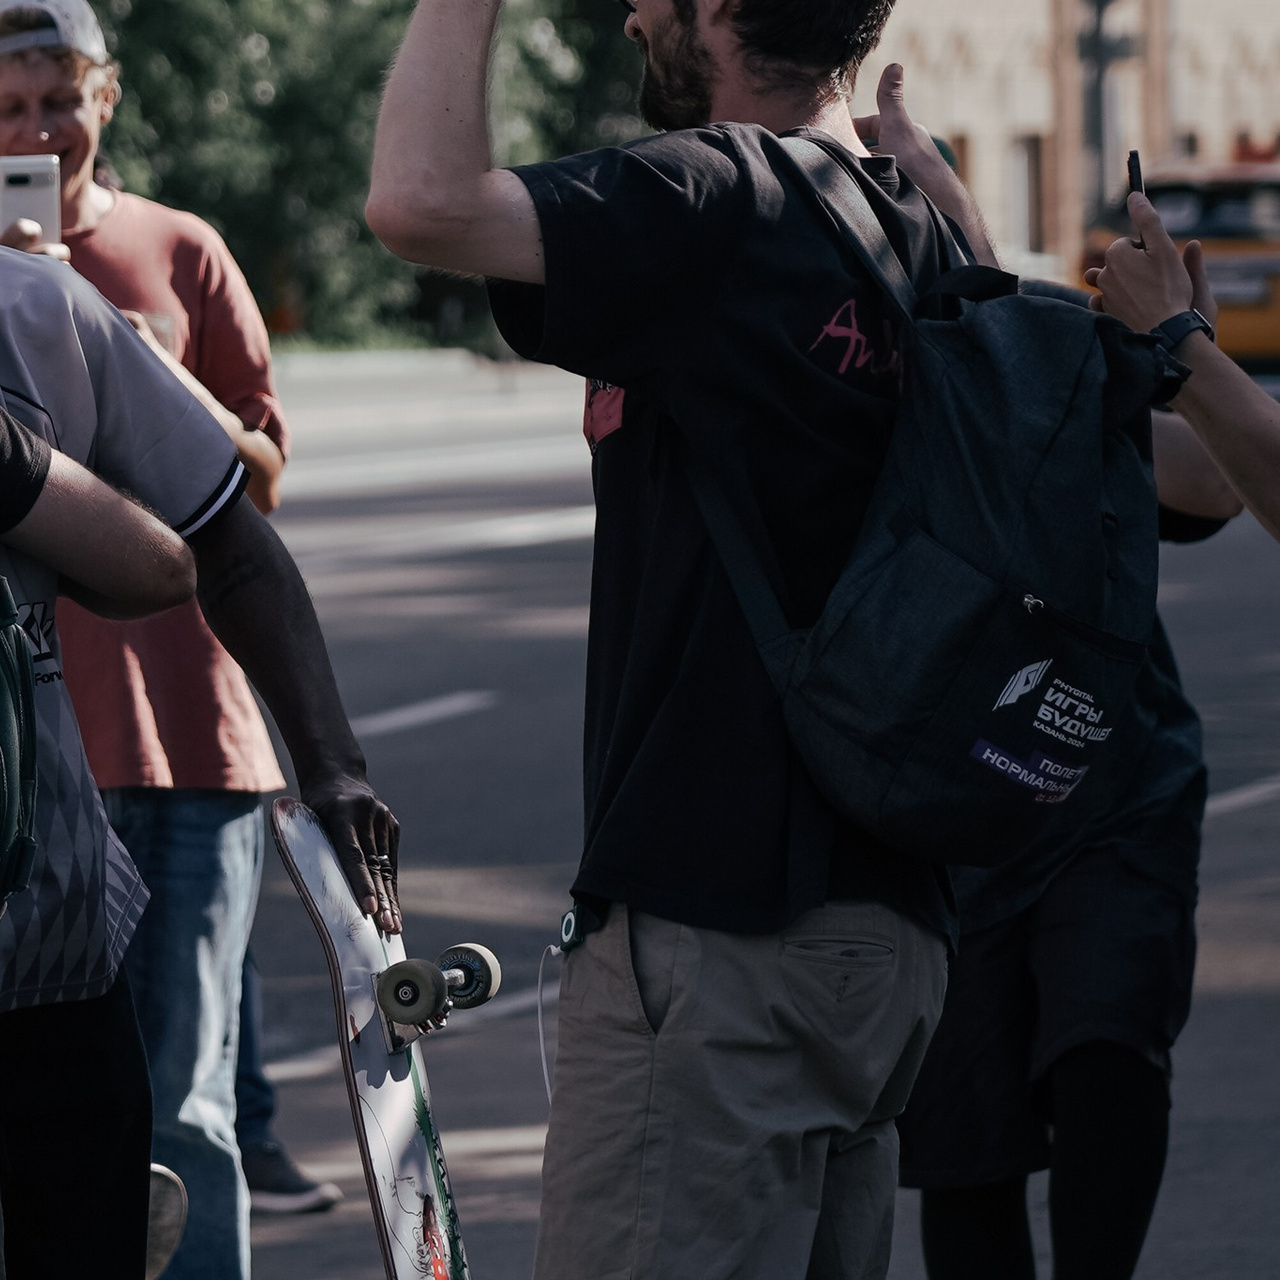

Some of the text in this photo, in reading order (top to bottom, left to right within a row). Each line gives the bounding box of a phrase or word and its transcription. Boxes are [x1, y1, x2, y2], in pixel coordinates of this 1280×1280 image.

[1052, 678, 1095, 703] PHYGITAL
[1044, 686, 1104, 724] ИГРЫ
[1032, 719, 1086, 749] КАЗАНЬ 2024
[1038, 758, 1082, 780] ПОЛЕТ
